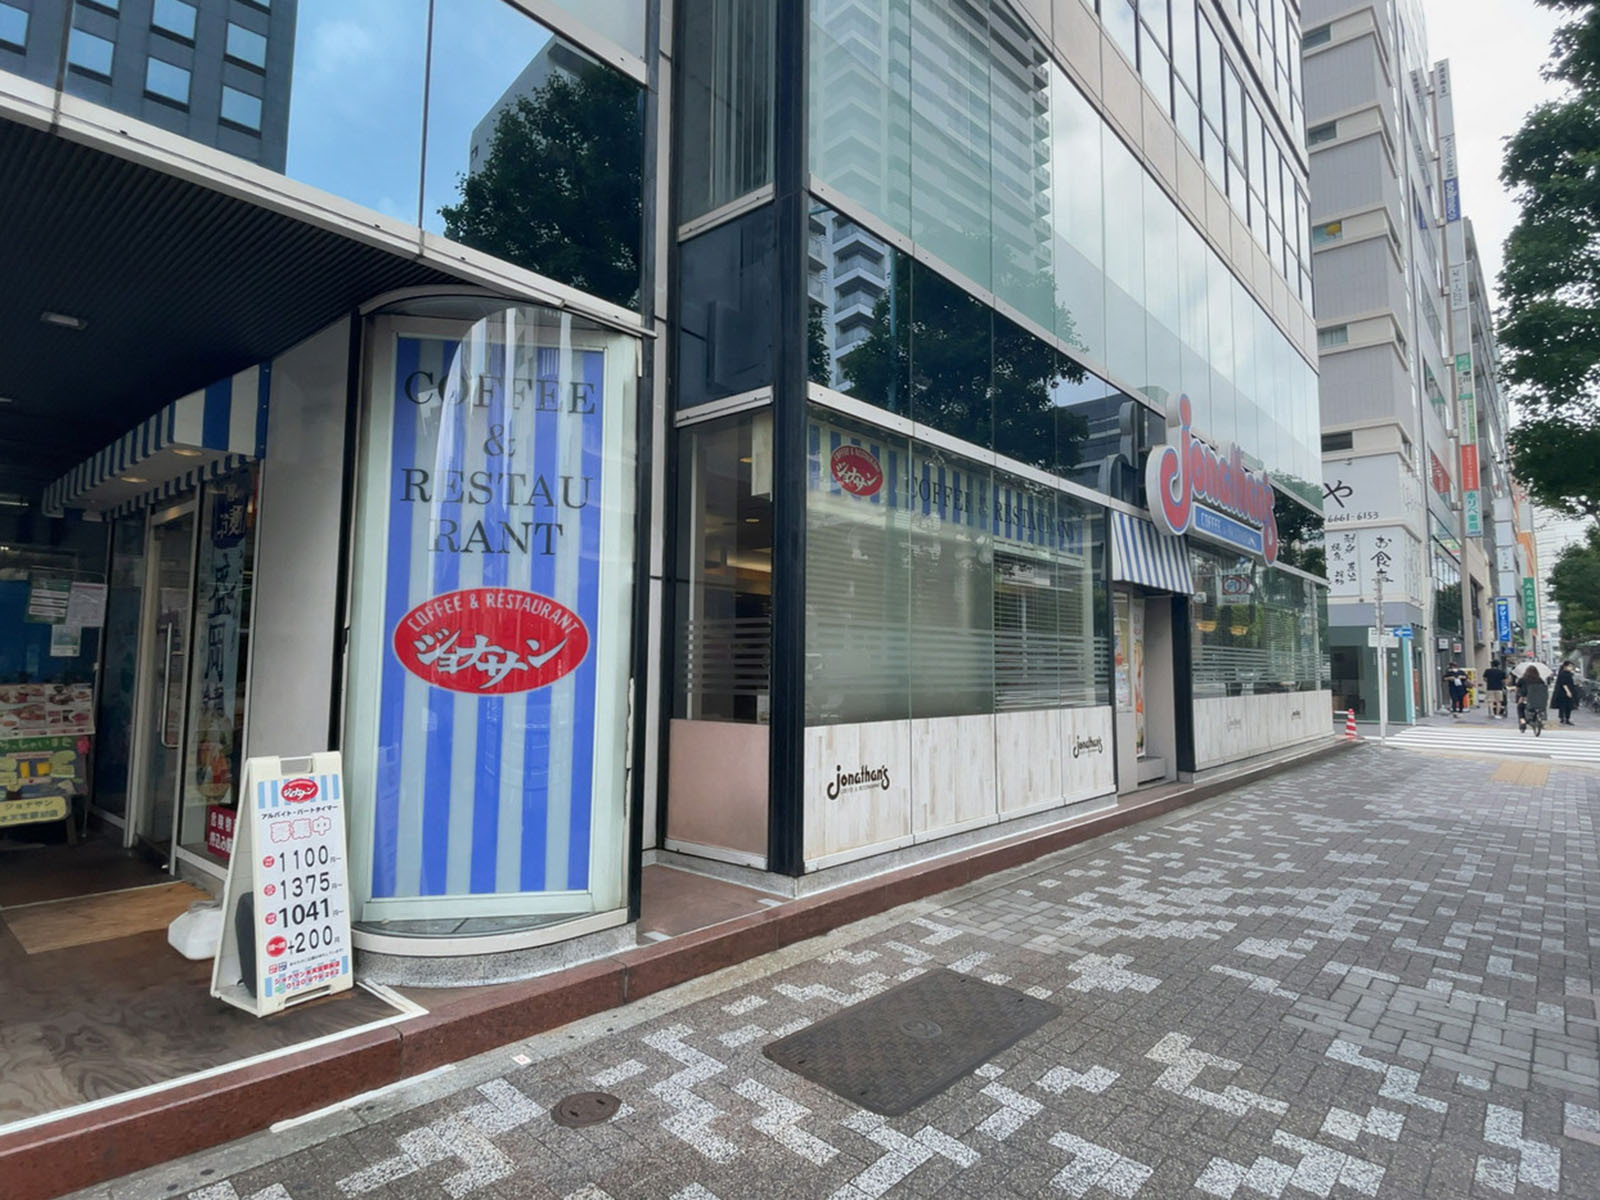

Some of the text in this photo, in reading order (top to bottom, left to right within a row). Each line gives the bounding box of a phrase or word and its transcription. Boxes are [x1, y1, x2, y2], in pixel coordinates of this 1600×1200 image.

[404, 371, 596, 415] COFFEE
[483, 424, 516, 458] &
[400, 468, 594, 510] RESTAU
[429, 519, 564, 556] RANT
[407, 592, 580, 635] COFFEE & RESTAURANT
[412, 627, 569, 689] ジョナサン
